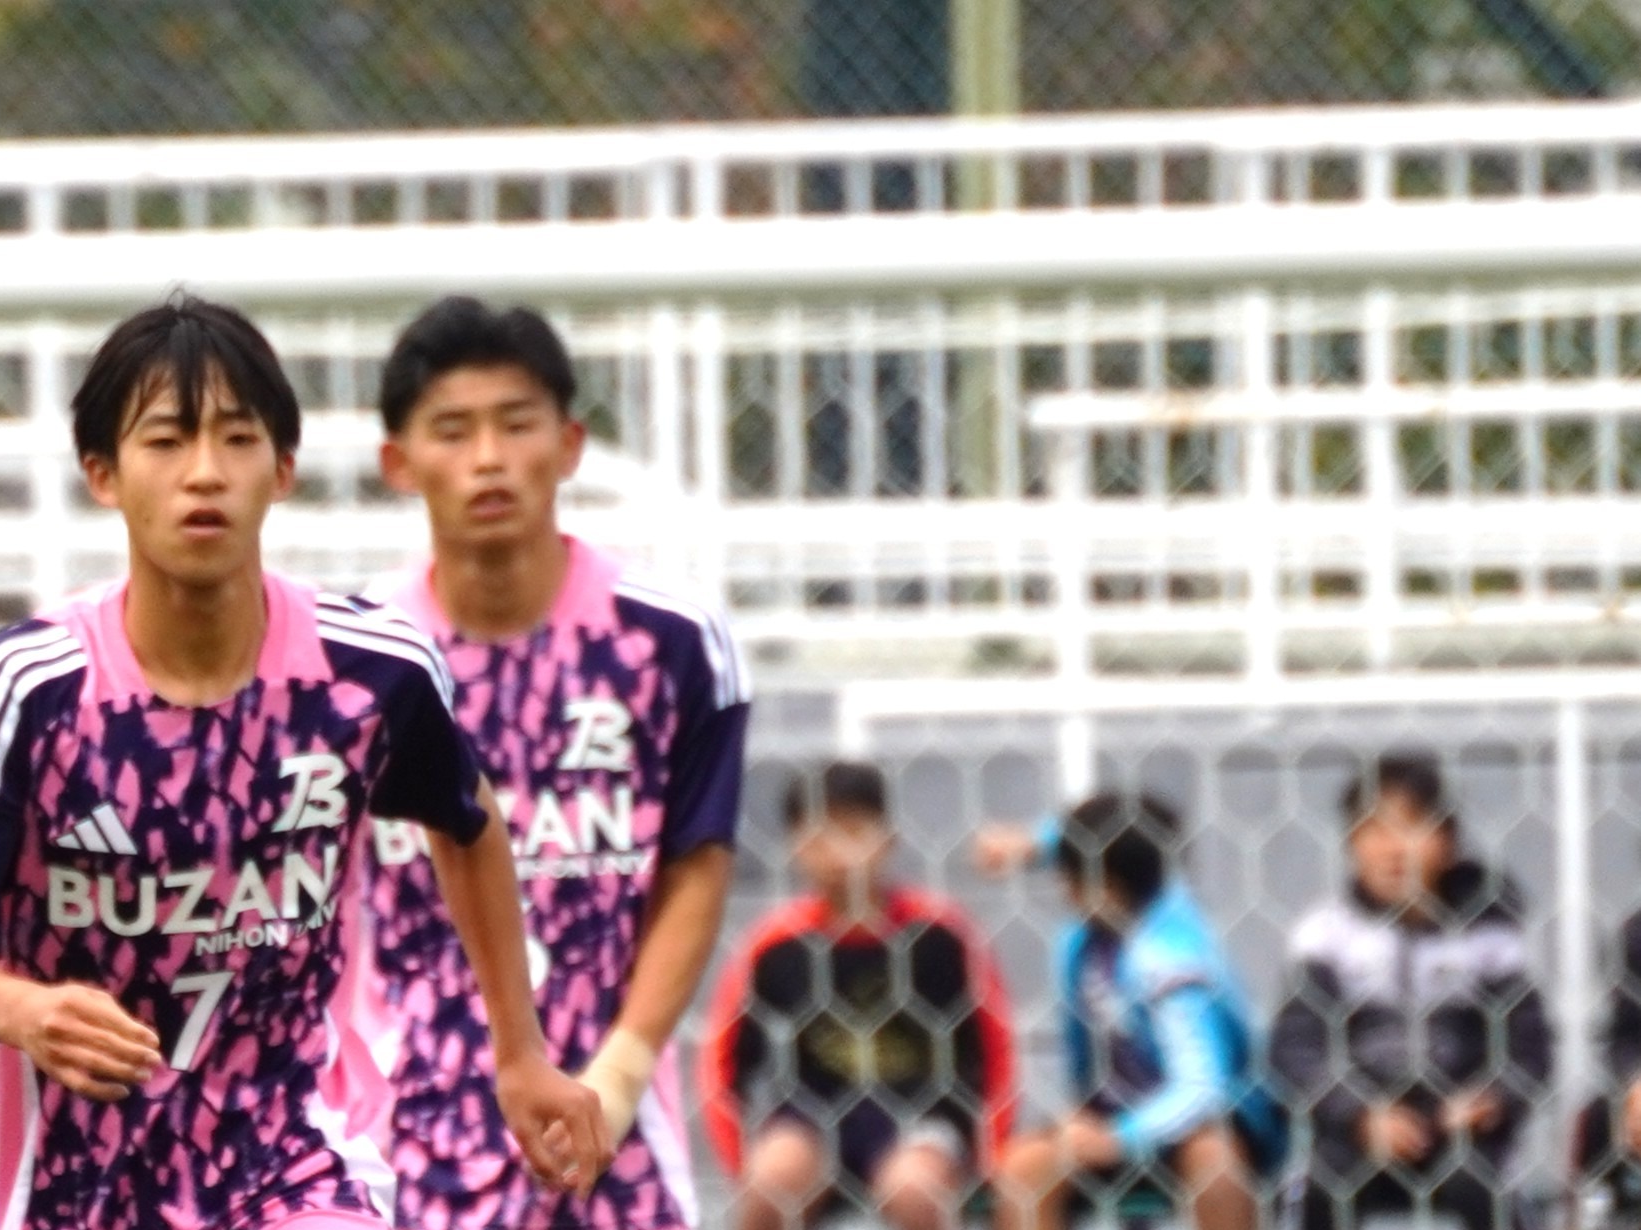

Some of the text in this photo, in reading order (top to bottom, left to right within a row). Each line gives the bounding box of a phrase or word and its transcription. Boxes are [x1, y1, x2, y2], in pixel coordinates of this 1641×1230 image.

[46, 844, 338, 937] BUZAN
[194, 922, 289, 957] NIHON
[169, 970, 234, 1072] 7
